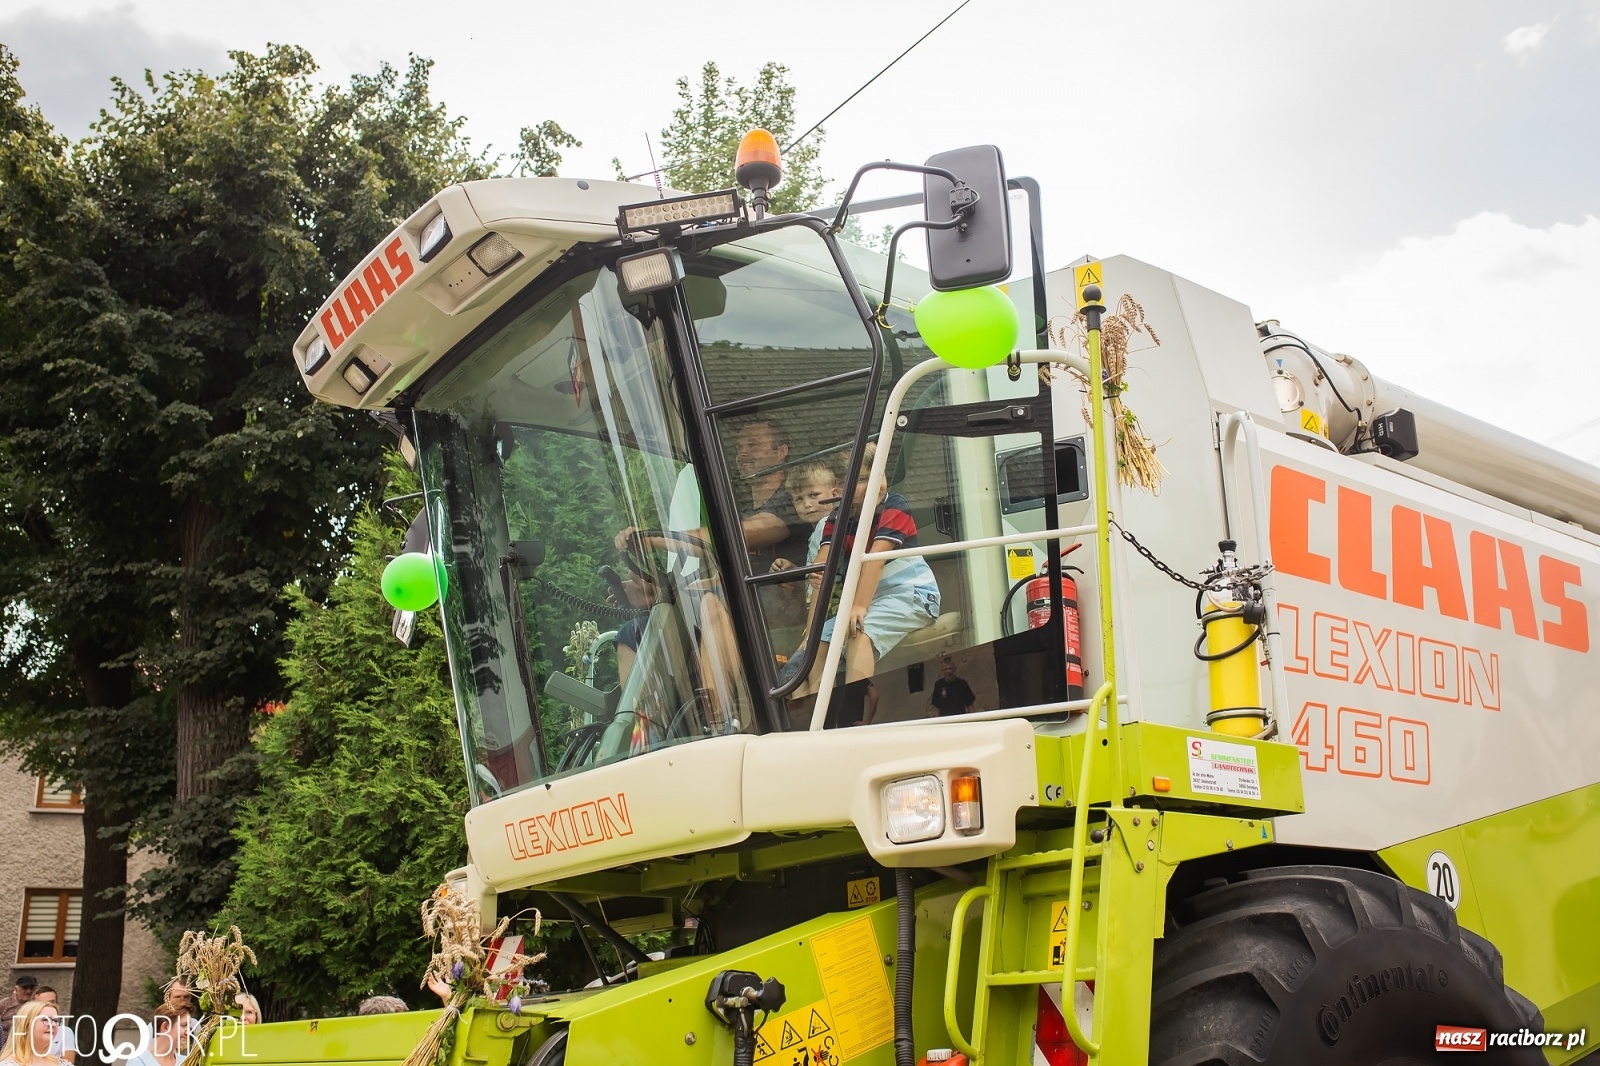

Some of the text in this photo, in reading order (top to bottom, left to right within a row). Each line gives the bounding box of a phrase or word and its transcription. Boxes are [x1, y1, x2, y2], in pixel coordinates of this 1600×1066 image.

[320, 236, 414, 350] CLAAS
[1269, 464, 1589, 654] CLAAS
[1276, 602, 1501, 712] LEXION
[1214, 763, 1254, 774] LANDTECHNIK
[1291, 701, 1431, 786] 460
[505, 793, 633, 860] LEXION
[1432, 862, 1454, 902] 20
[1316, 960, 1437, 1048] Continental
